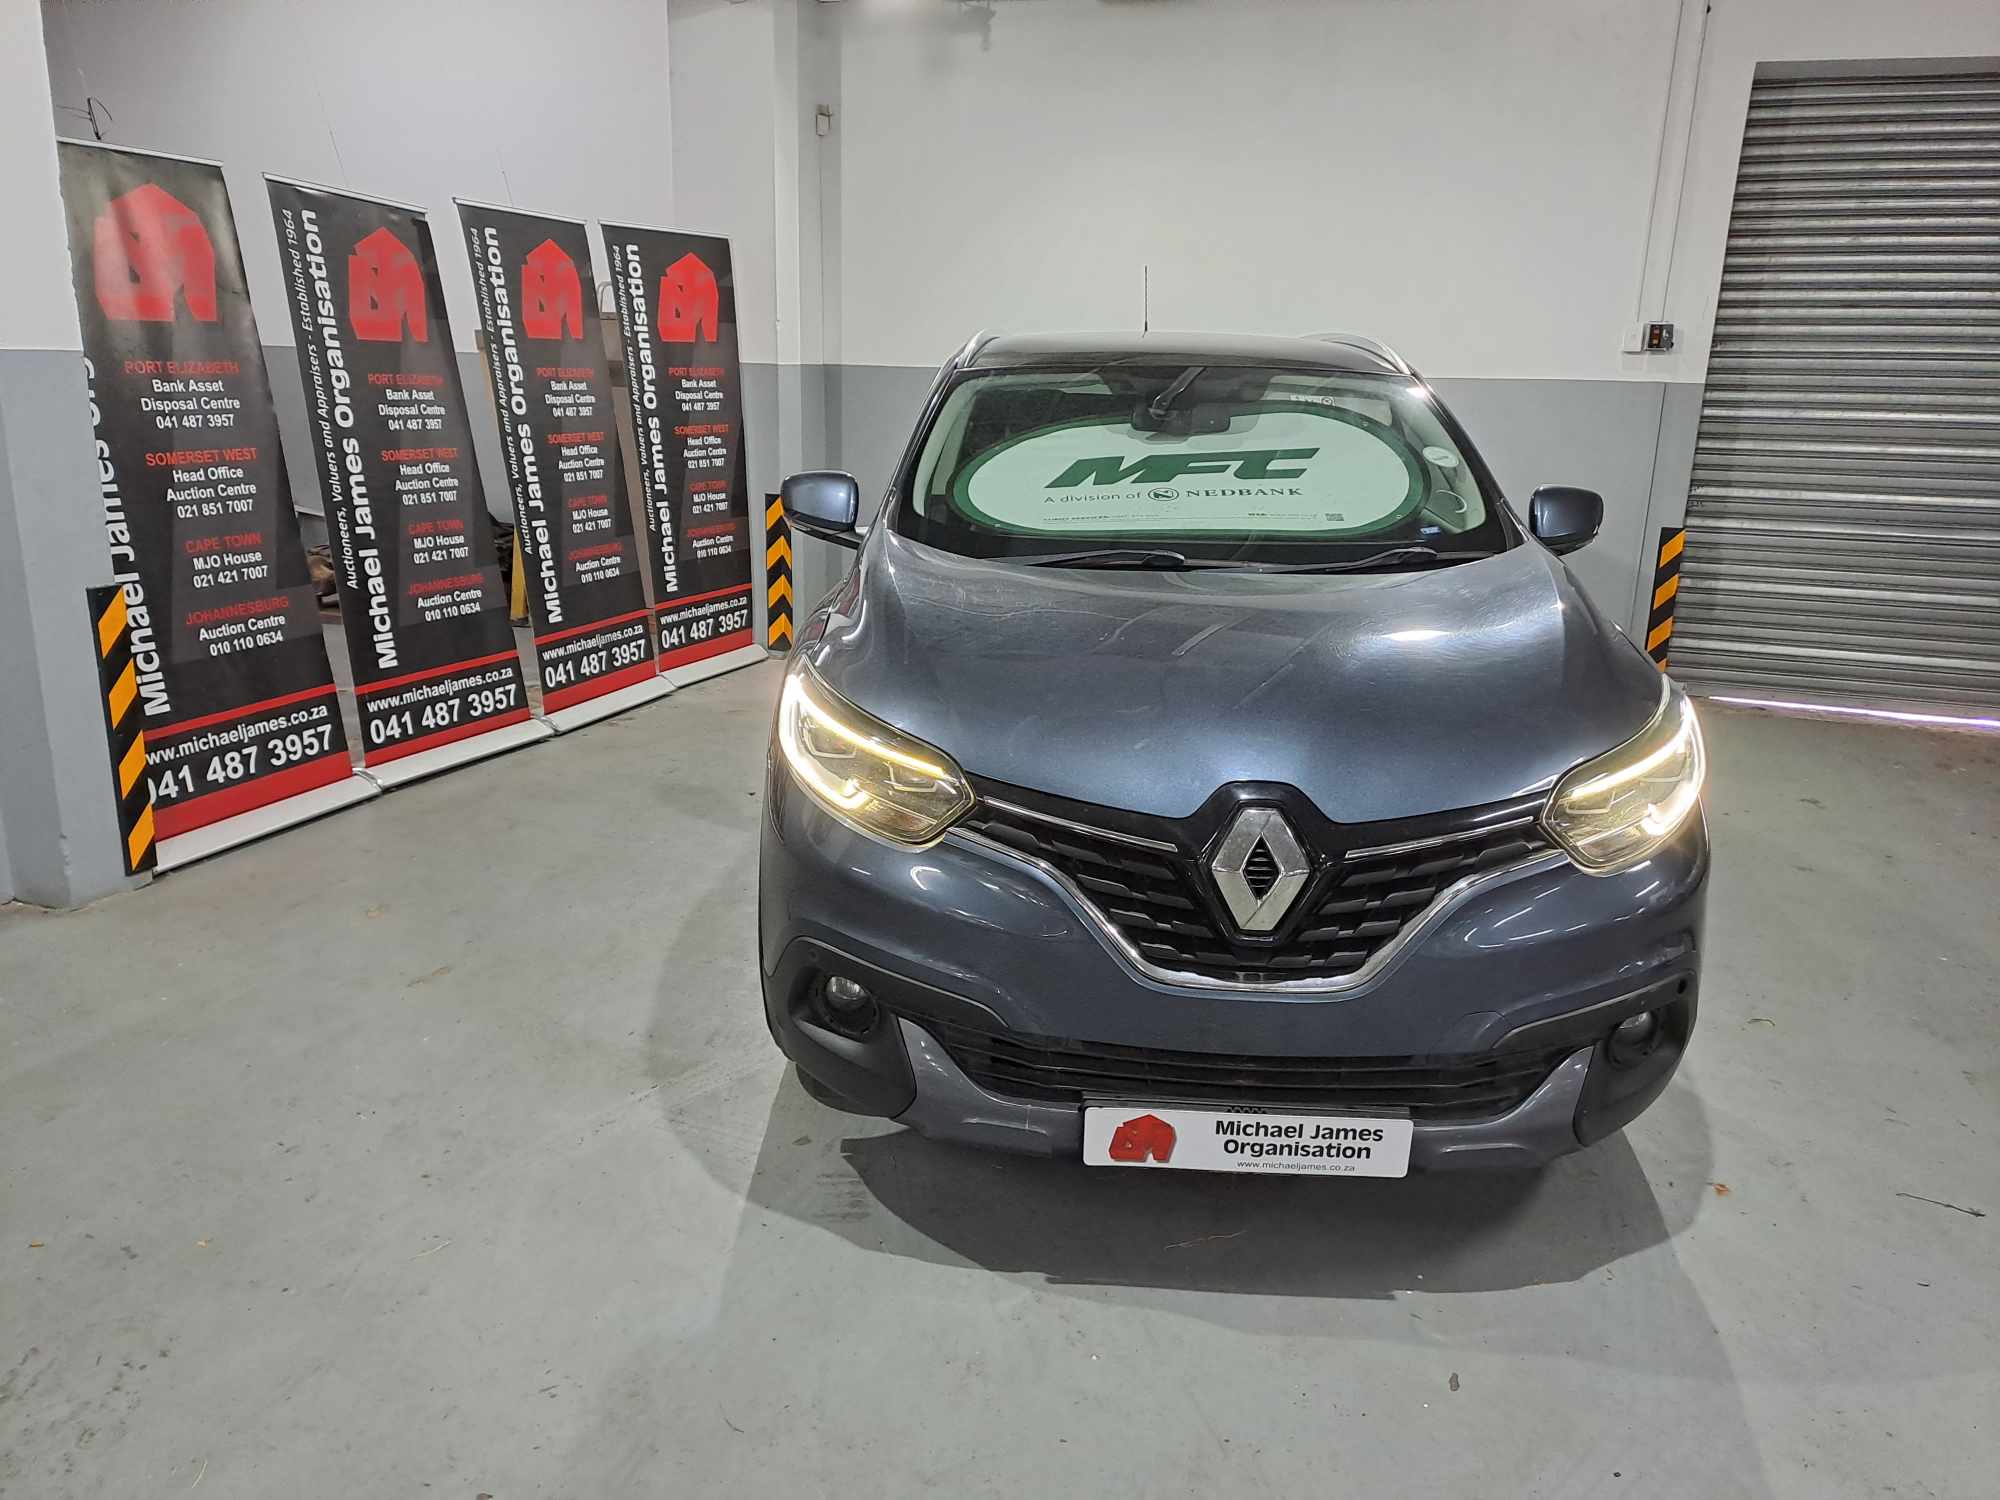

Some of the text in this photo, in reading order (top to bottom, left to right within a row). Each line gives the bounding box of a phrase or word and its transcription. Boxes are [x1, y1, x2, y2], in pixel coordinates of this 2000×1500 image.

[616, 275, 631, 336] Established
[124, 361, 161, 374] PORT
[626, 346, 641, 402] Appraisers
[152, 379, 225, 393] Bank Asset
[385, 389, 435, 400] Bank Asset
[470, 228, 533, 555] Auctioneers, Valuers and Appraisers Established 1964
[675, 391, 703, 401] Disposal
[140, 397, 241, 413] Disposal Centre
[282, 208, 359, 589] Auctioneers, Valuers and Appraisers Established 1964
[544, 394, 574, 405] Disposal
[378, 404, 446, 417] Disposal Centre
[626, 244, 679, 593] Michael James Organisation
[634, 404, 643, 425] and
[156, 414, 234, 429] 041 487 3957
[388, 419, 442, 431] 041 487 3957
[484, 227, 563, 624] Michael James Organisation
[301, 210, 399, 669] Michael James Organisation
[637, 427, 646, 465] Valuers
[145, 447, 257, 466] SOMERSET WEST
[561, 445, 598, 456] Head Office
[683, 448, 707, 458] Auction
[399, 463, 450, 475] Head Office
[558, 457, 605, 470] Auction Centre
[1044, 447, 1320, 488] MFC
[173, 466, 244, 483] Head Office
[394, 477, 459, 492] Auction Centre
[563, 471, 576, 483] 021
[576, 470, 588, 482] 851
[166, 483, 257, 502] Auction Centre
[402, 490, 457, 506] 021 851 7007
[1044, 487, 1303, 504] A division of NEDBANK
[177, 499, 253, 519] 021 851 7007
[587, 508, 609, 518] House
[572, 522, 584, 534] 021
[185, 532, 262, 553] CAPE TOWN
[413, 535, 465, 549] MJO House
[193, 550, 263, 571] MJO House
[413, 547, 469, 564] 021 421 7007
[575, 560, 600, 572] Auction
[193, 565, 268, 589] 021 421 7007
[417, 588, 482, 608] Auction Centre
[186, 596, 289, 626] JOHANNESBURG
[424, 601, 481, 622] 010 110 0634
[660, 596, 748, 625] www.michaeljames.co.za
[199, 614, 286, 641] Auction Centre
[661, 609, 748, 649] 041 487 3957
[114, 572, 171, 716] Michael
[209, 630, 284, 657] 010 110 0634
[542, 623, 643, 661] www.michaeljames.co.za
[544, 639, 646, 689] 041 487 3957
[367, 667, 513, 713] www.michaeljames.co.za
[370, 683, 517, 744] 041 487 3957
[145, 705, 328, 766] ww.michaeljames.co.za
[206, 745, 258, 784] 487
[267, 723, 332, 766] 3957
[1215, 1120, 1384, 1142] Michael James
[1223, 1138, 1372, 1159] Organisation
[1237, 1160, 1356, 1172] www.michaeljames.co.za
